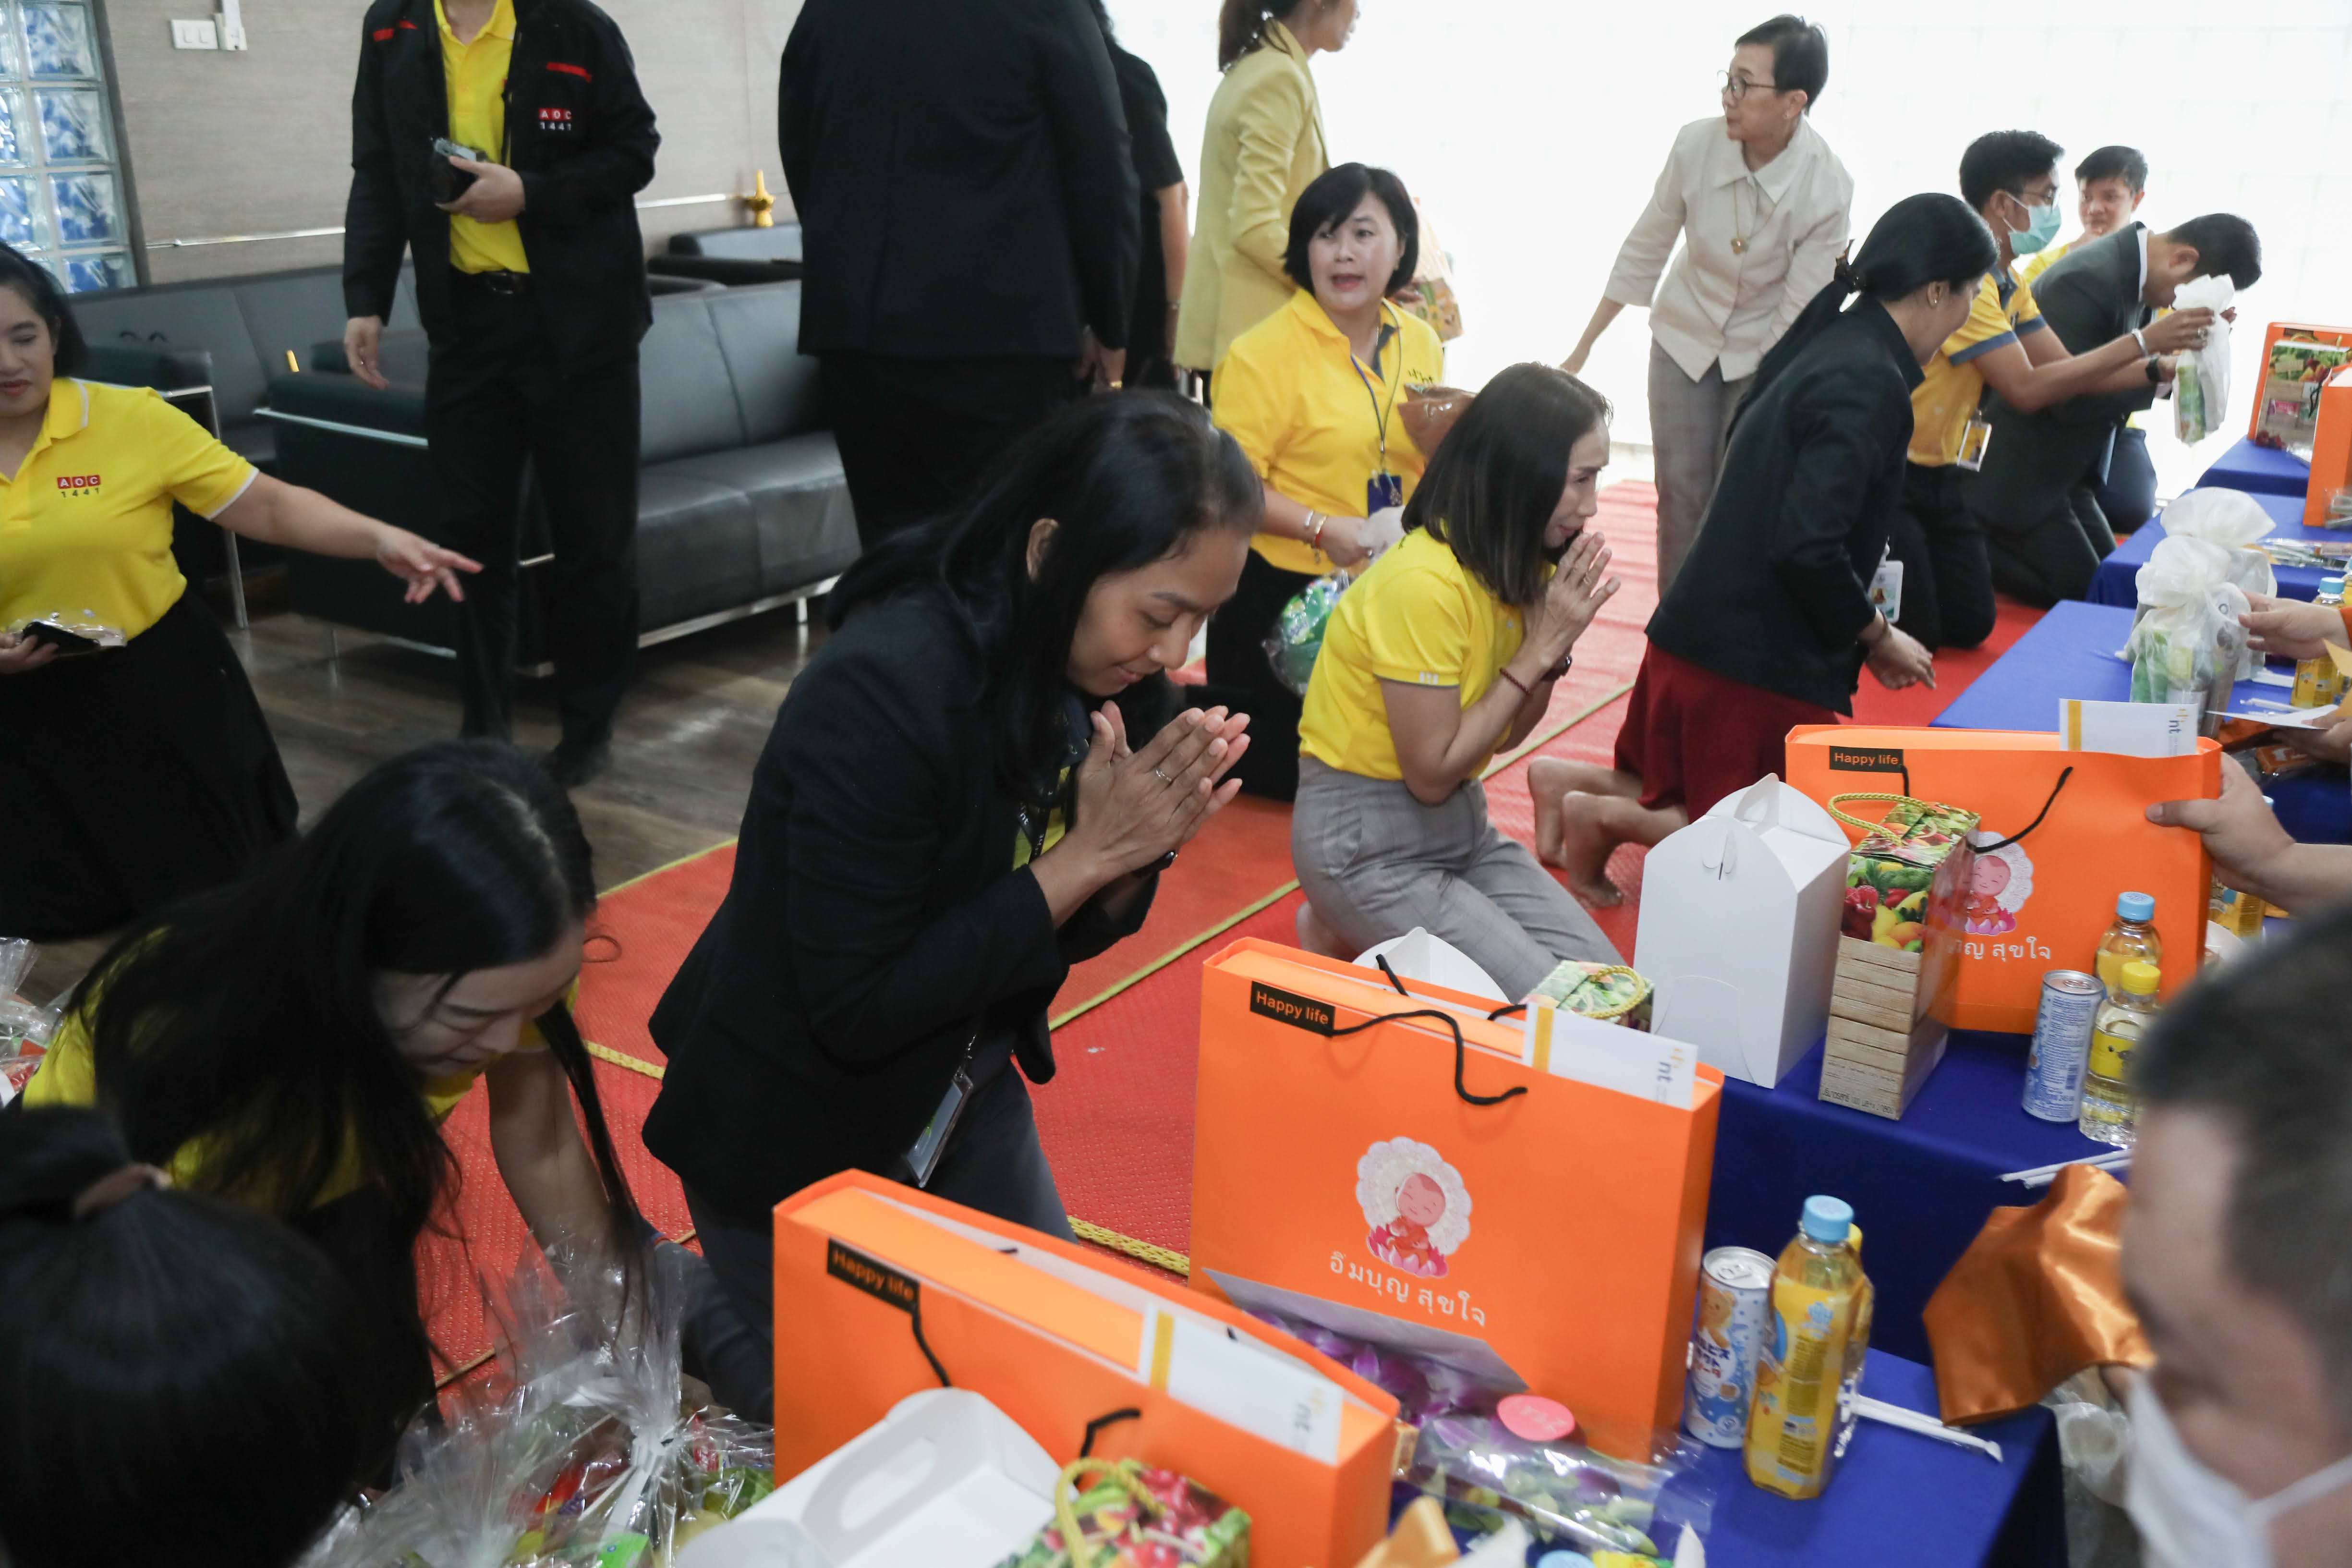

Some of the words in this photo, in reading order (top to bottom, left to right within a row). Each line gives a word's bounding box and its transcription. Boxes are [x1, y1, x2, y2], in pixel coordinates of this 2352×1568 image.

[541, 109, 572, 120] AOC
[539, 121, 571, 131] 1441
[60, 476, 99, 487] AOC
[61, 487, 99, 498] 1441
[1834, 752, 1876, 767] Happy
[1879, 754, 1899, 765] life
[1992, 936, 2051, 962] สุขใจ
[1256, 990, 1303, 1019] Happy
[1305, 1006, 1329, 1025] life
[833, 1249, 886, 1290] Happy
[887, 1275, 915, 1301] life
[1418, 1288, 1486, 1327] สุขใจ
